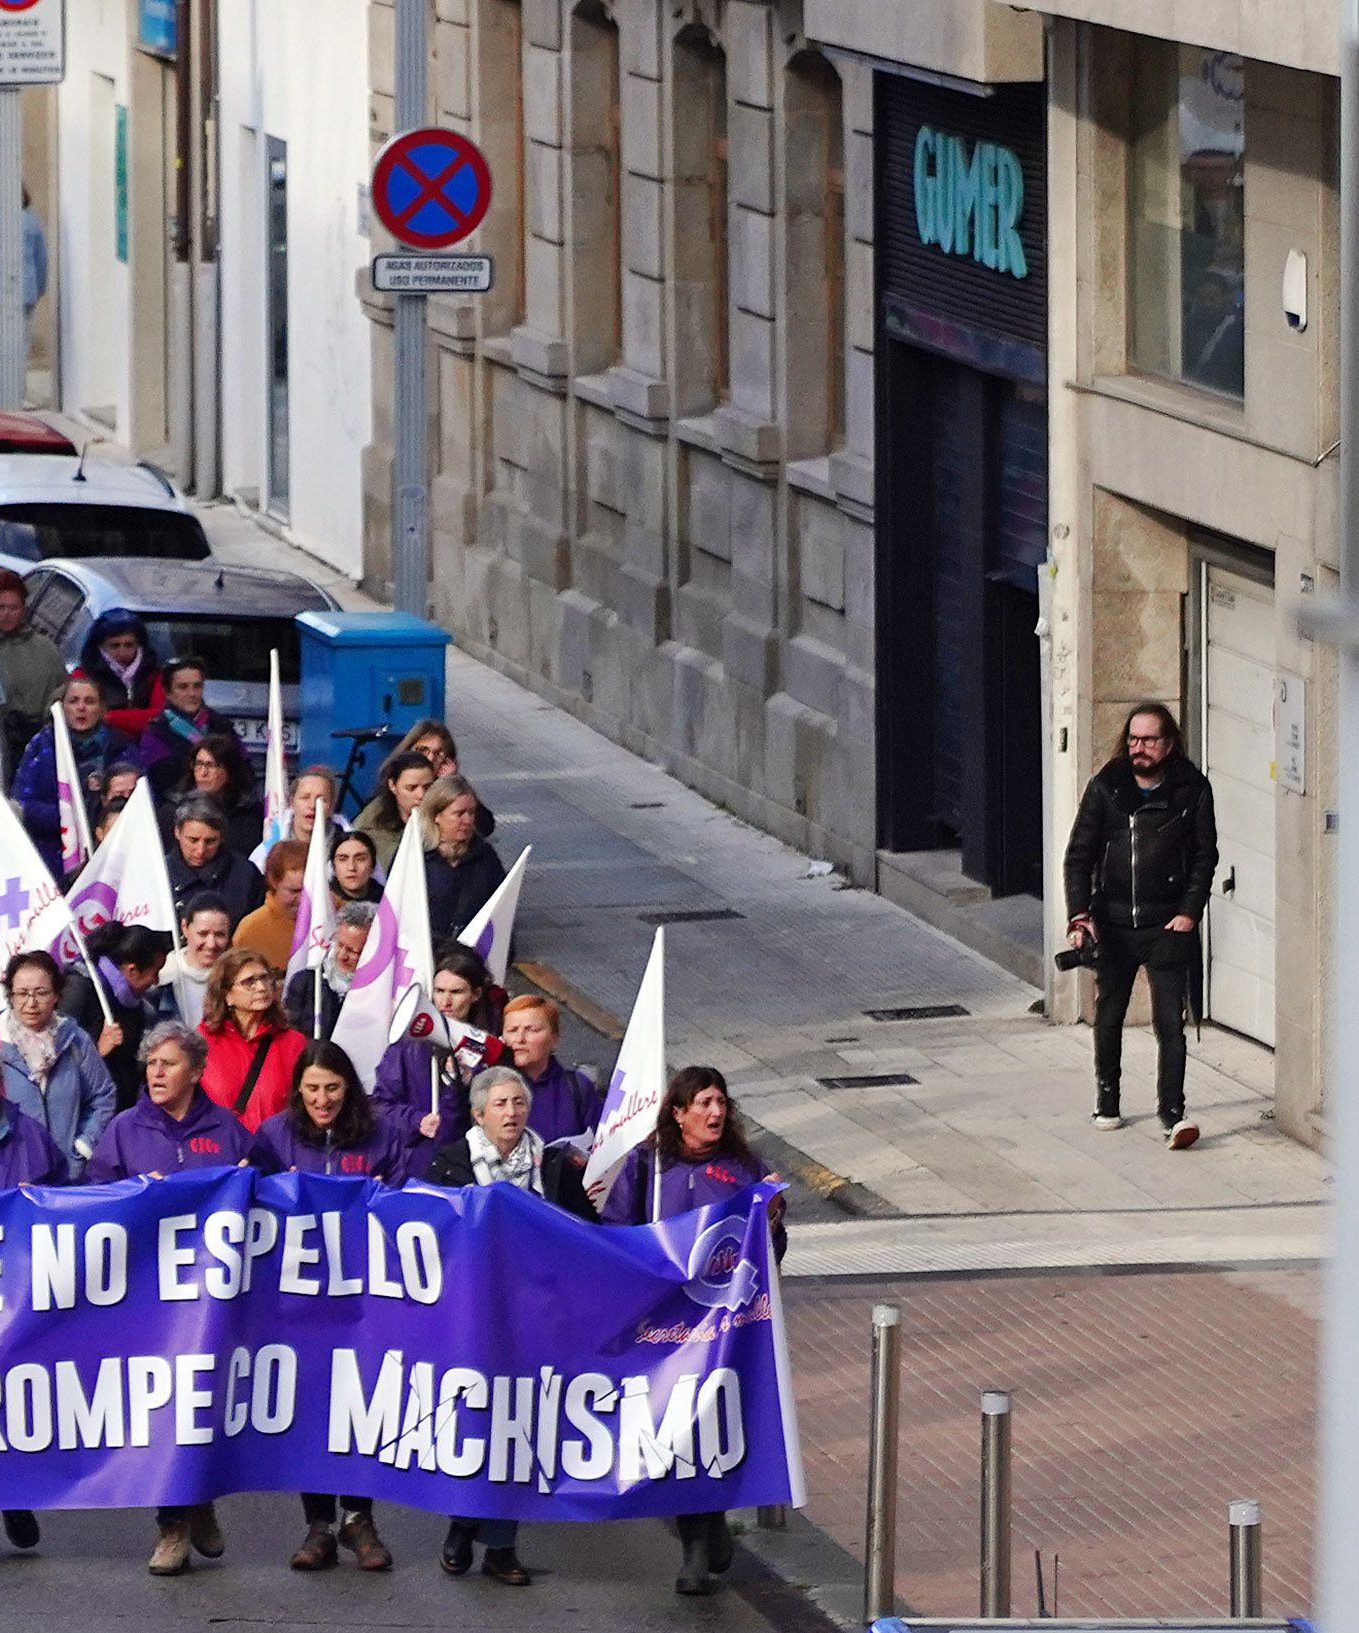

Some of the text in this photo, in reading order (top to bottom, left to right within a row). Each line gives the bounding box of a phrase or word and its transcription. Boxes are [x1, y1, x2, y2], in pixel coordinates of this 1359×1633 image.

[914, 125, 1028, 279] GUMER
[31, 1222, 129, 1311] NO
[158, 1207, 443, 1305] ESPELLO
[224, 1344, 298, 1438] CO
[328, 1348, 745, 1494] MACHISMO
